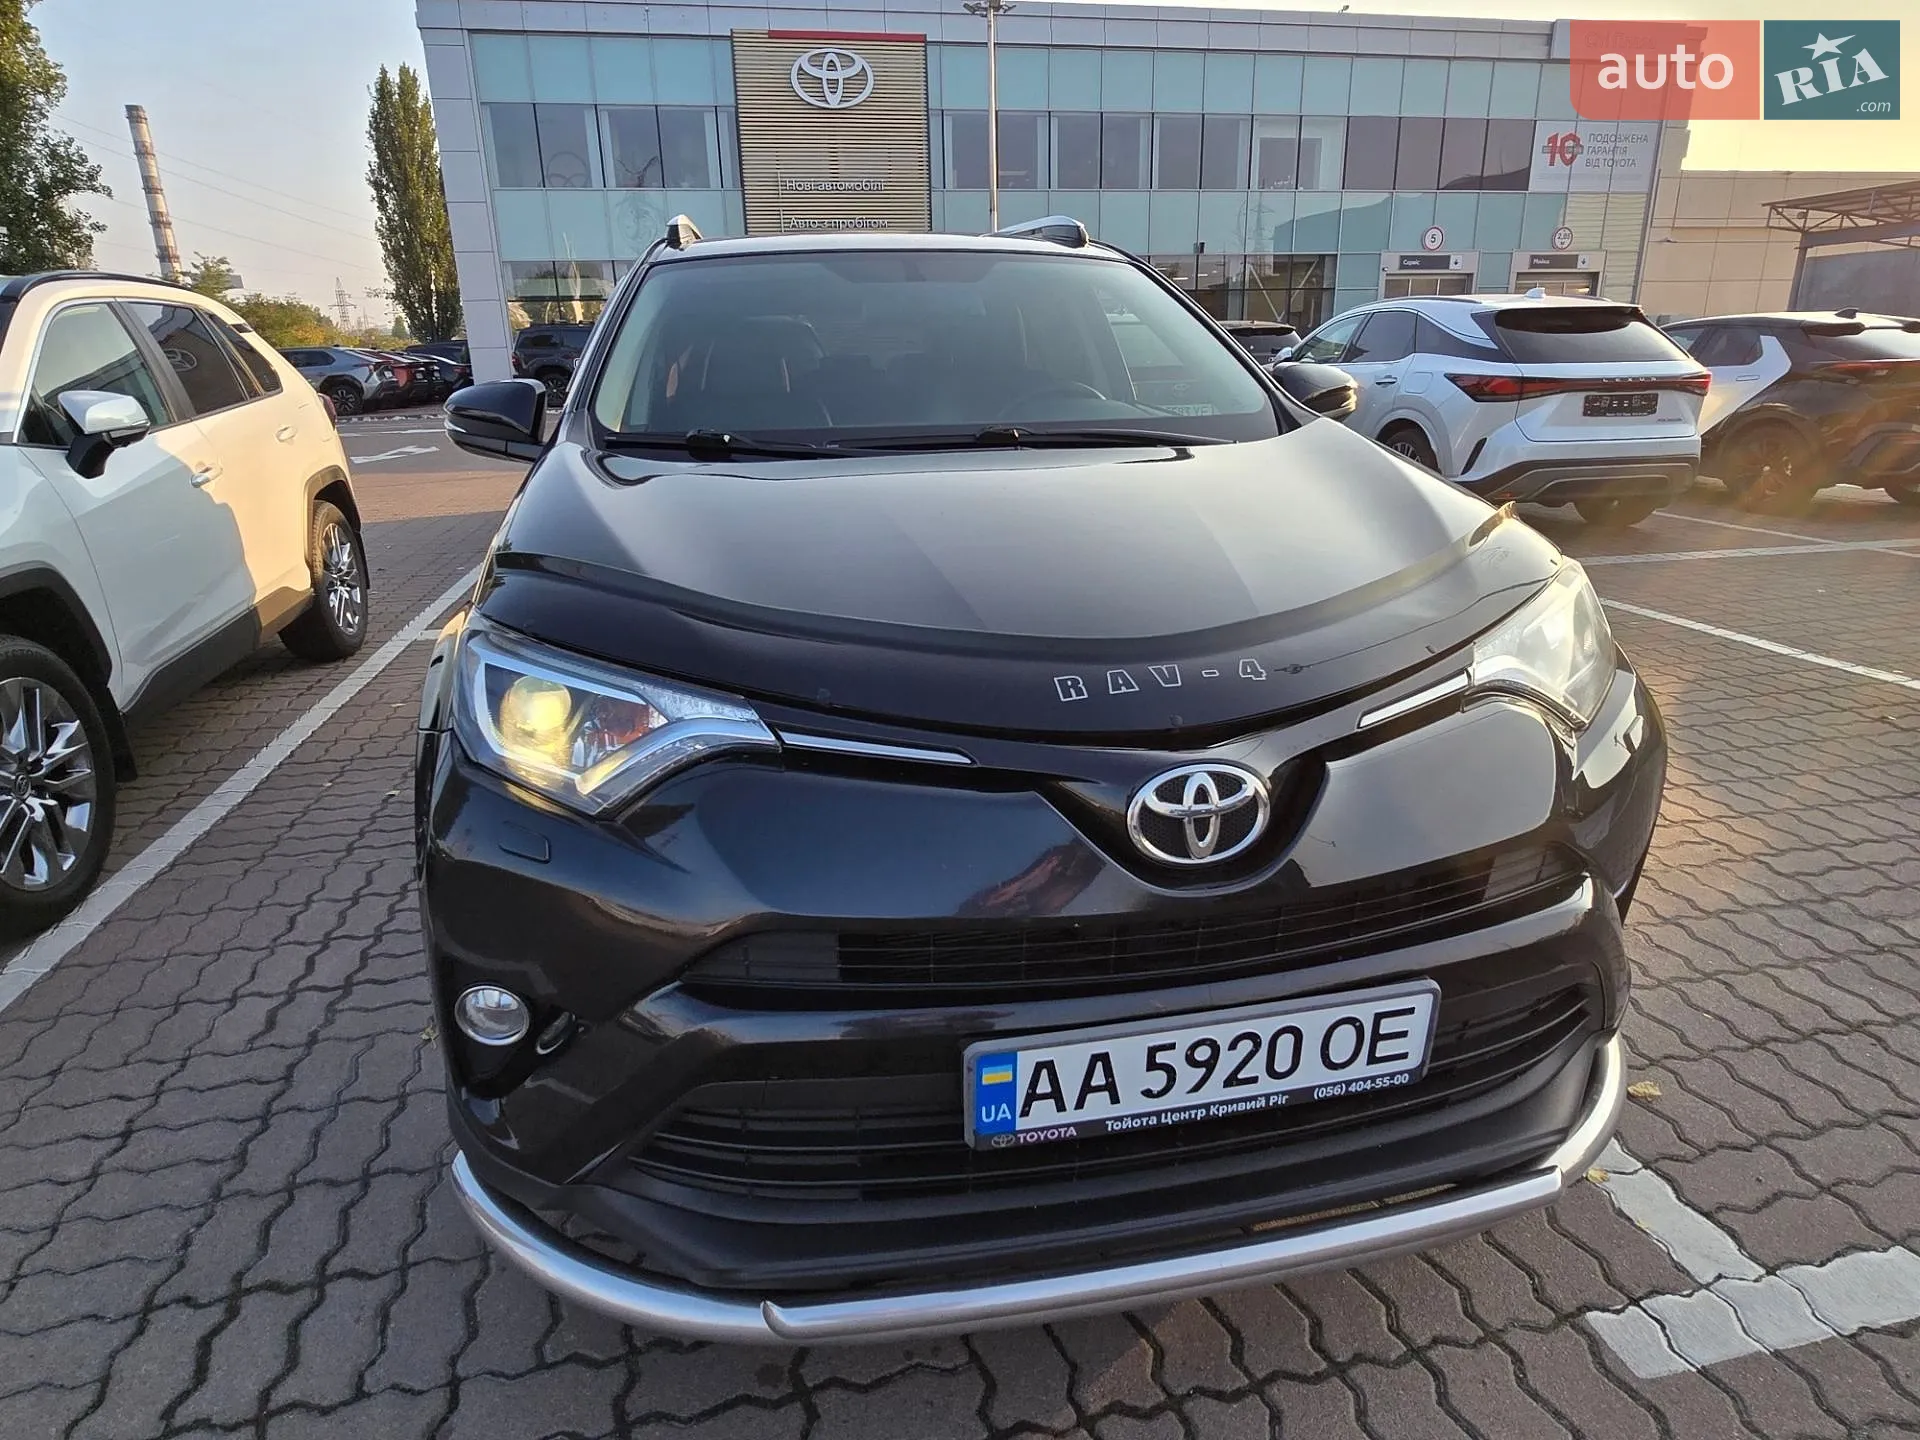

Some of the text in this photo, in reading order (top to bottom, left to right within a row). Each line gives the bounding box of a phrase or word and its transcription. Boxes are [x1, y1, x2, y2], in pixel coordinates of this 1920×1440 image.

[1588, 133, 1649, 144] ПОДОВЖЕНА
[1587, 145, 1628, 155] ГАРАНТІЯ
[1585, 158, 1637, 168] ВІД TOYOTA
[786, 179, 884, 191] Нові автомобілі
[790, 217, 818, 229] Авто
[831, 217, 888, 232] пробігом
[1430, 233, 1437, 244] 5
[1018, 1006, 1416, 1118] AA 5920 OE
[1312, 1073, 1410, 1101] (056) 404-55-00
[981, 1104, 1013, 1124] UA
[1105, 1093, 1290, 1132] Тойота Центр Кривий Ріг
[1017, 1126, 1078, 1145] TOYOTA
